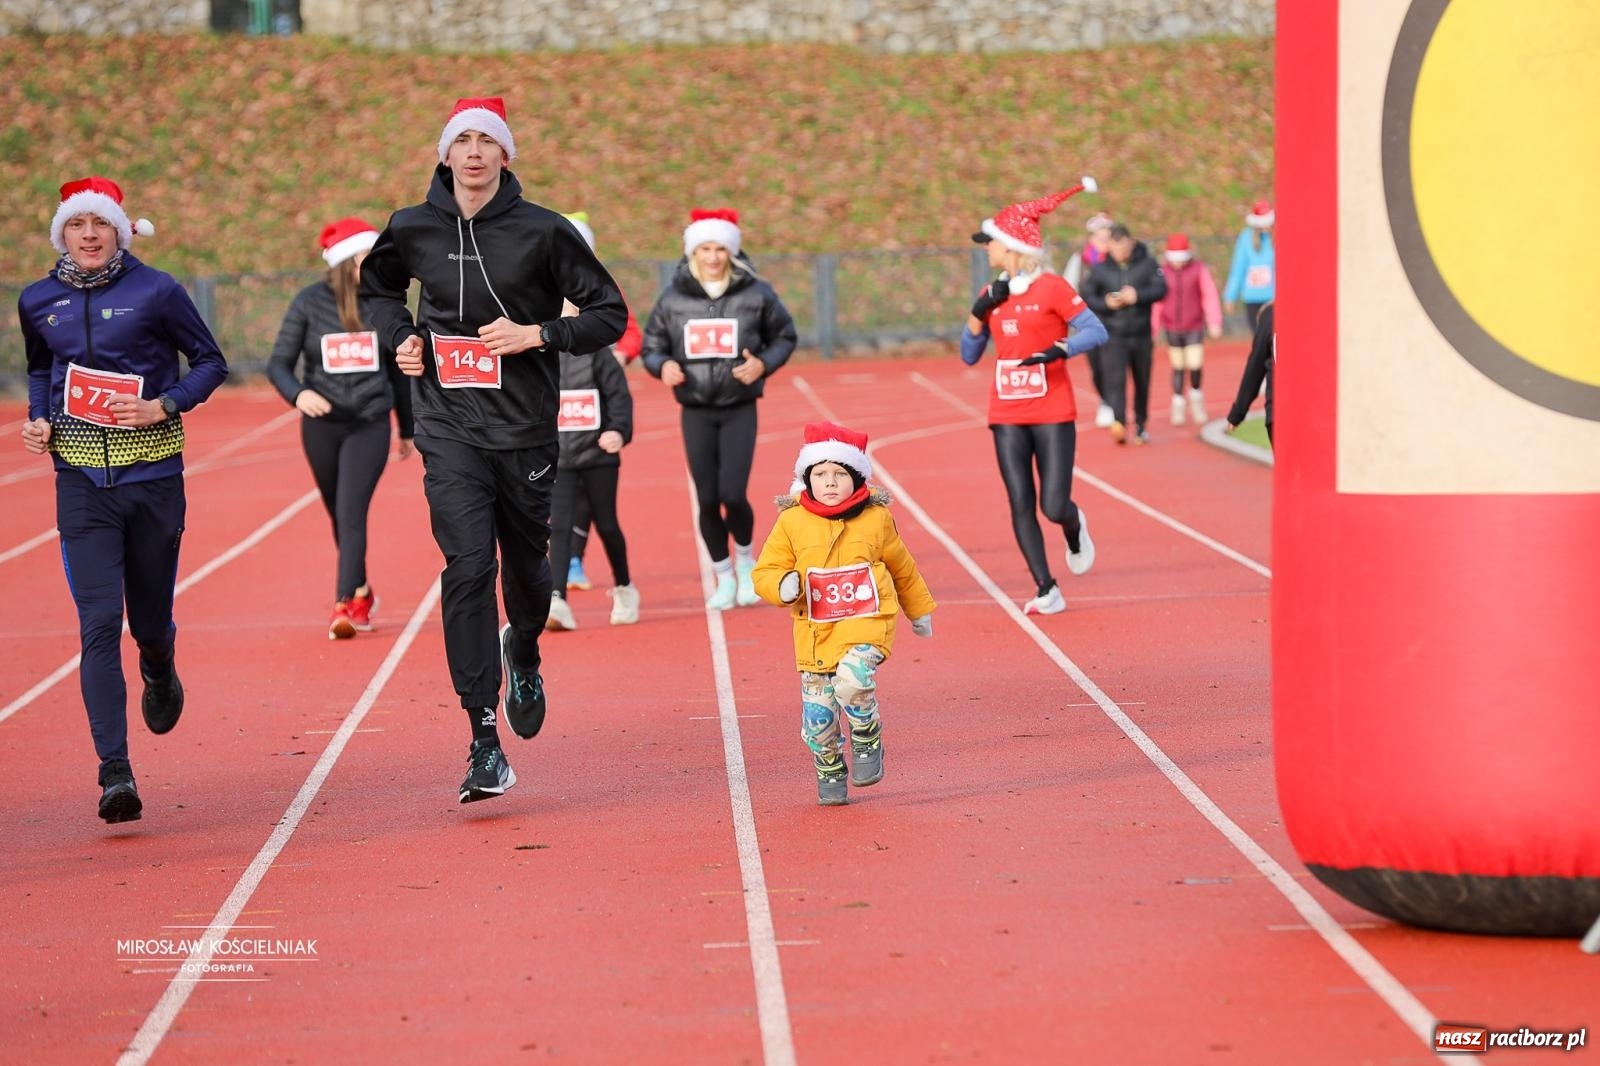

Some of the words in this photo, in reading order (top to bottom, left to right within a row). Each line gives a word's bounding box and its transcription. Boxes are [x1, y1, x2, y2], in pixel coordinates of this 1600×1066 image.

[706, 329, 717, 346] 1
[449, 349, 476, 369] 14
[1010, 370, 1030, 387] 57
[87, 385, 117, 408] 77
[825, 581, 855, 604] 33
